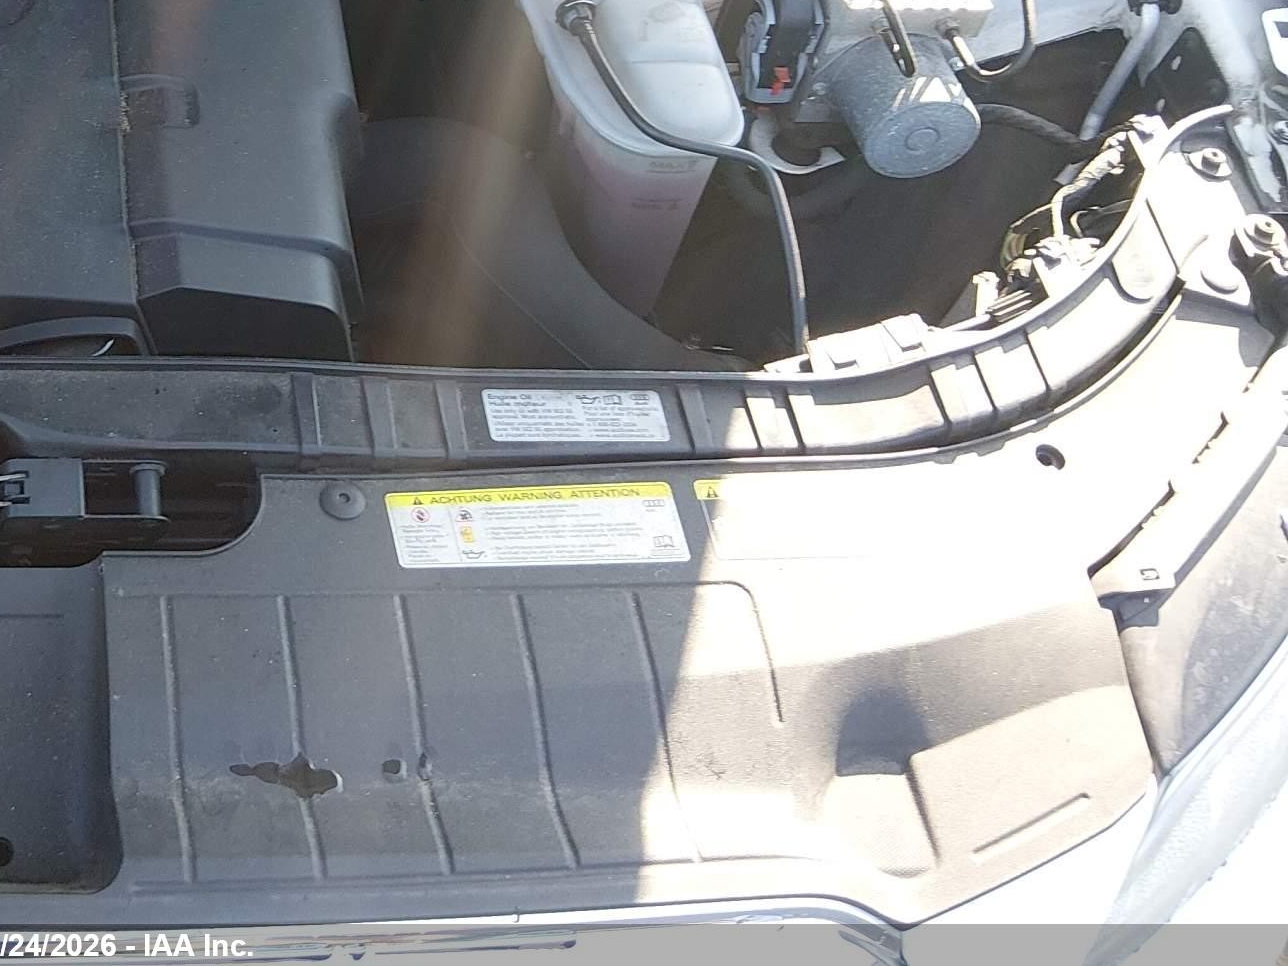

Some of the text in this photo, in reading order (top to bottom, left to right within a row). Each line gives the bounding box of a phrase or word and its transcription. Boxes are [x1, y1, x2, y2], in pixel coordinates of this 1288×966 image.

[487, 393, 518, 402] Engine
[431, 488, 640, 505] ACHTUNG WARNING ATTENTION
